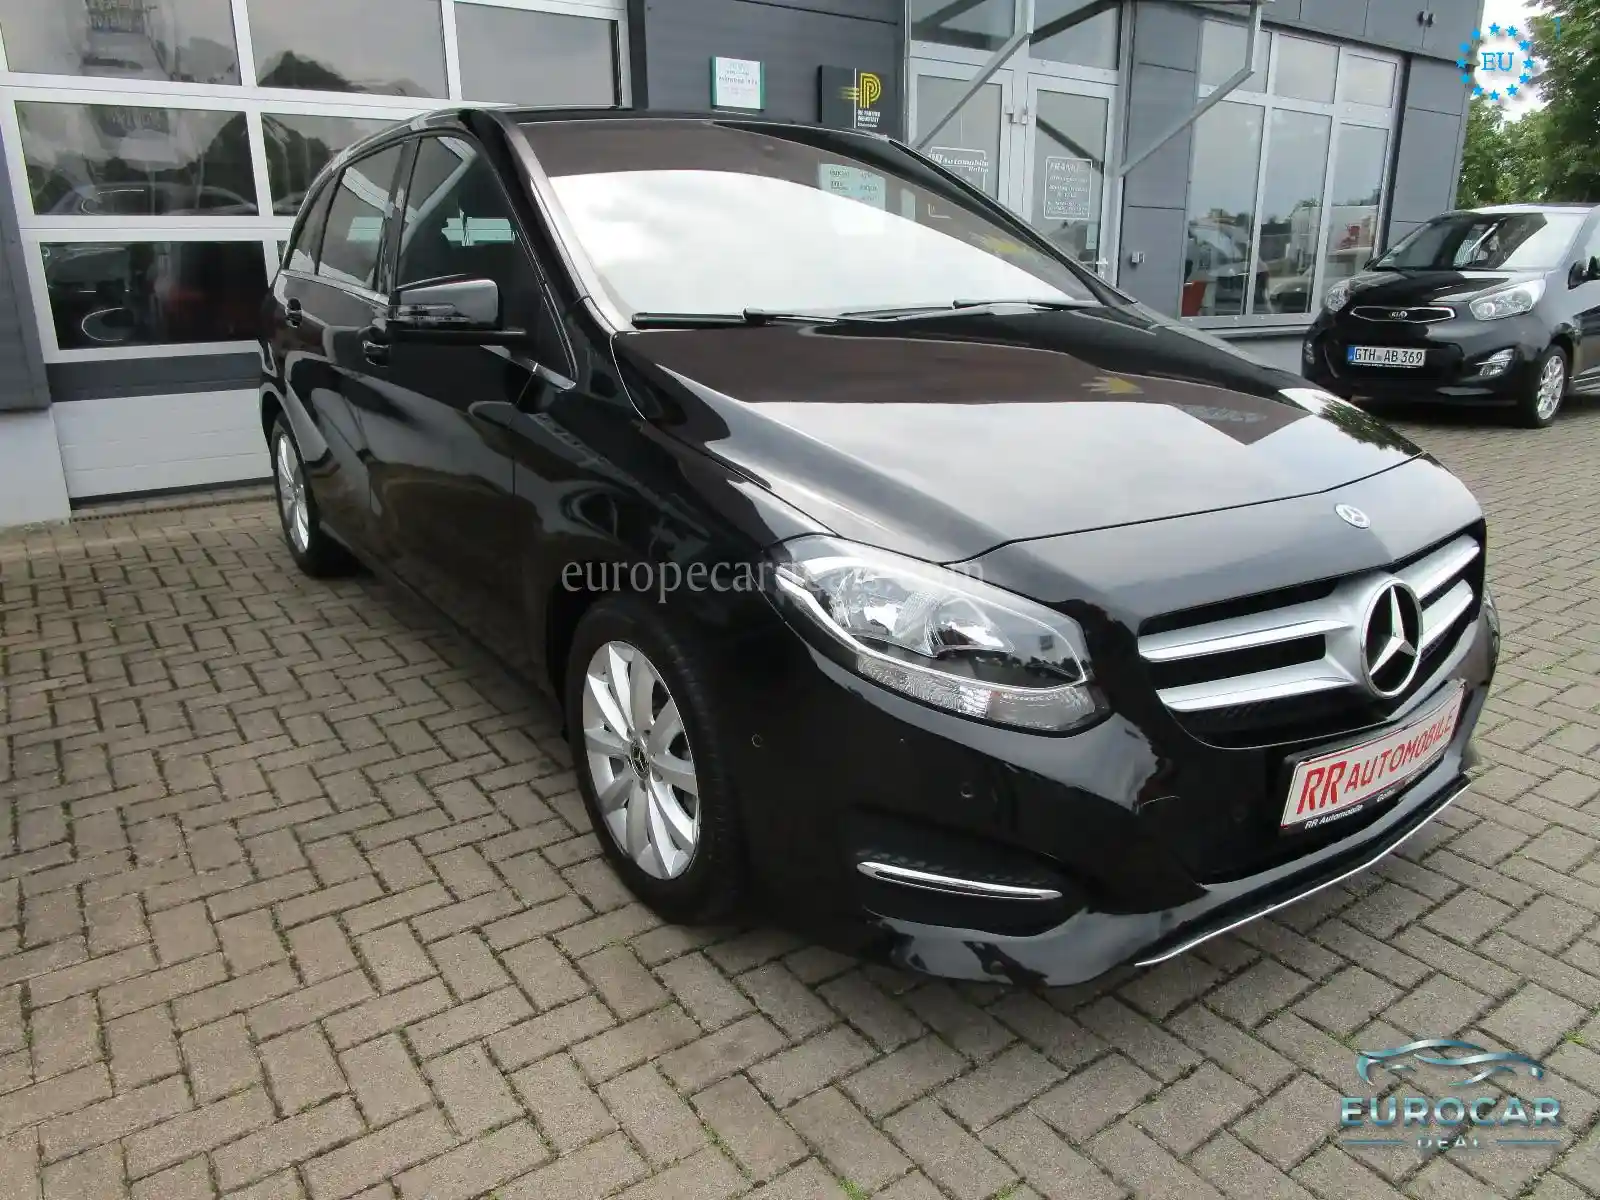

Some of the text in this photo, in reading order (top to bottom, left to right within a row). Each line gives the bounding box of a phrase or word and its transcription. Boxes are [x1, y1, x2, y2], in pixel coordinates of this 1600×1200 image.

[1355, 348, 1423, 364] GTH AB 369
[1297, 760, 1348, 814] RR
[1344, 705, 1457, 794] AUTOMOBILE
